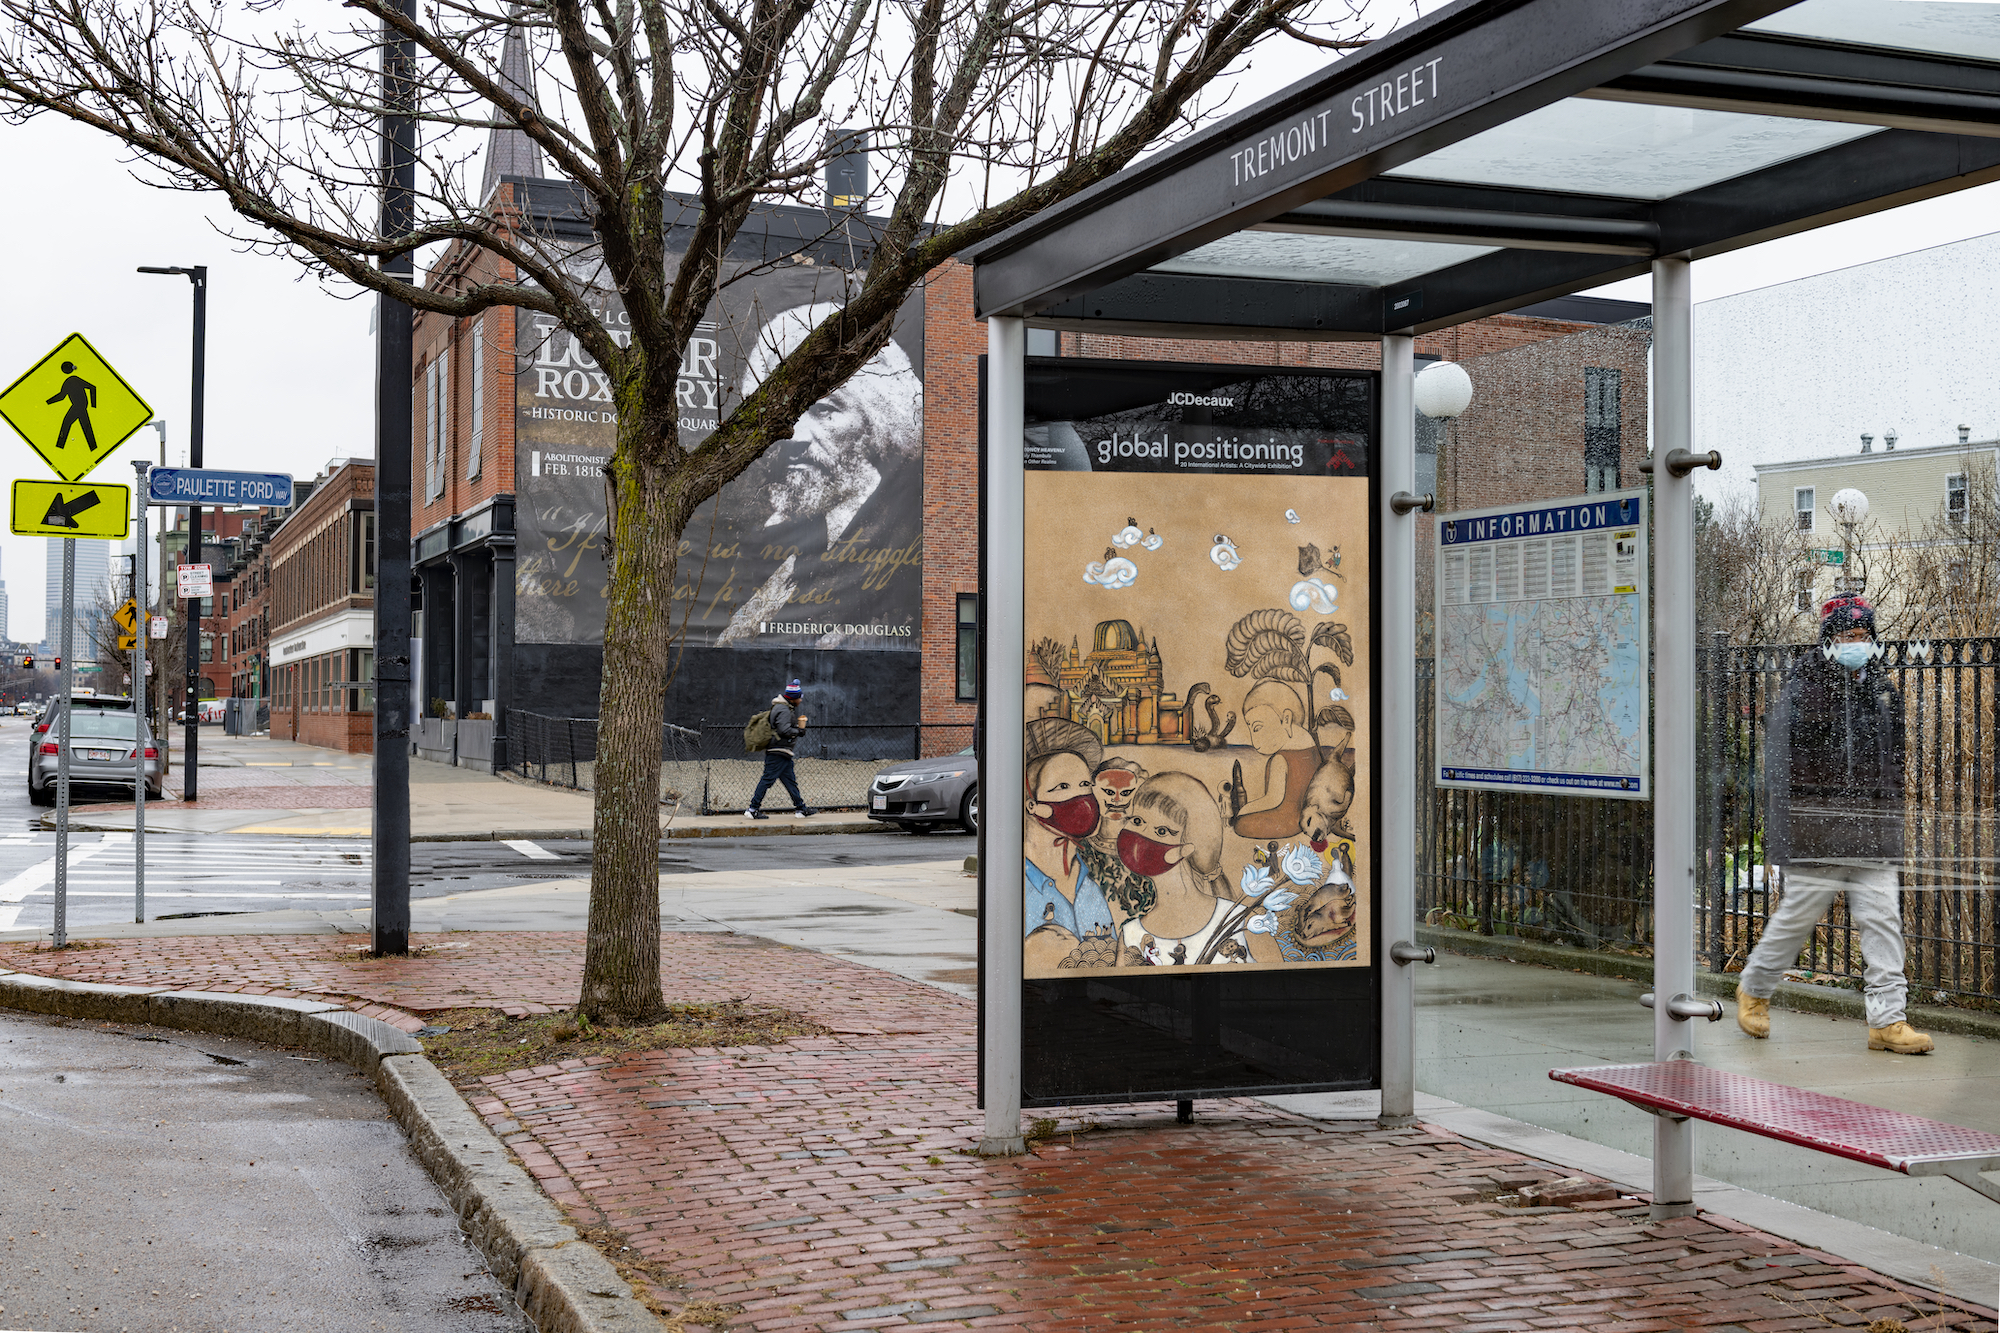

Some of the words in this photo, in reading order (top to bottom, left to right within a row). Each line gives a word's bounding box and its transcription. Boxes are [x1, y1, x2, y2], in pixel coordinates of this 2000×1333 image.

[1230, 109, 1332, 186] TREMONT
[1351, 56, 1443, 134] STREET
[1166, 391, 1235, 407] JCDecaux
[532, 406, 598, 423] HISTORIC
[1097, 432, 1169, 464] global
[1174, 436, 1304, 468] positioning
[545, 463, 571, 476] FEB.
[575, 466, 603, 478] 1818
[176, 477, 236, 498] PAULETTE
[241, 480, 273, 500] FORD
[275, 490, 289, 501] WAY
[1468, 505, 1606, 540] INFORMATION
[769, 621, 842, 636] FREDERICK
[845, 623, 911, 638] DOUGLASS
